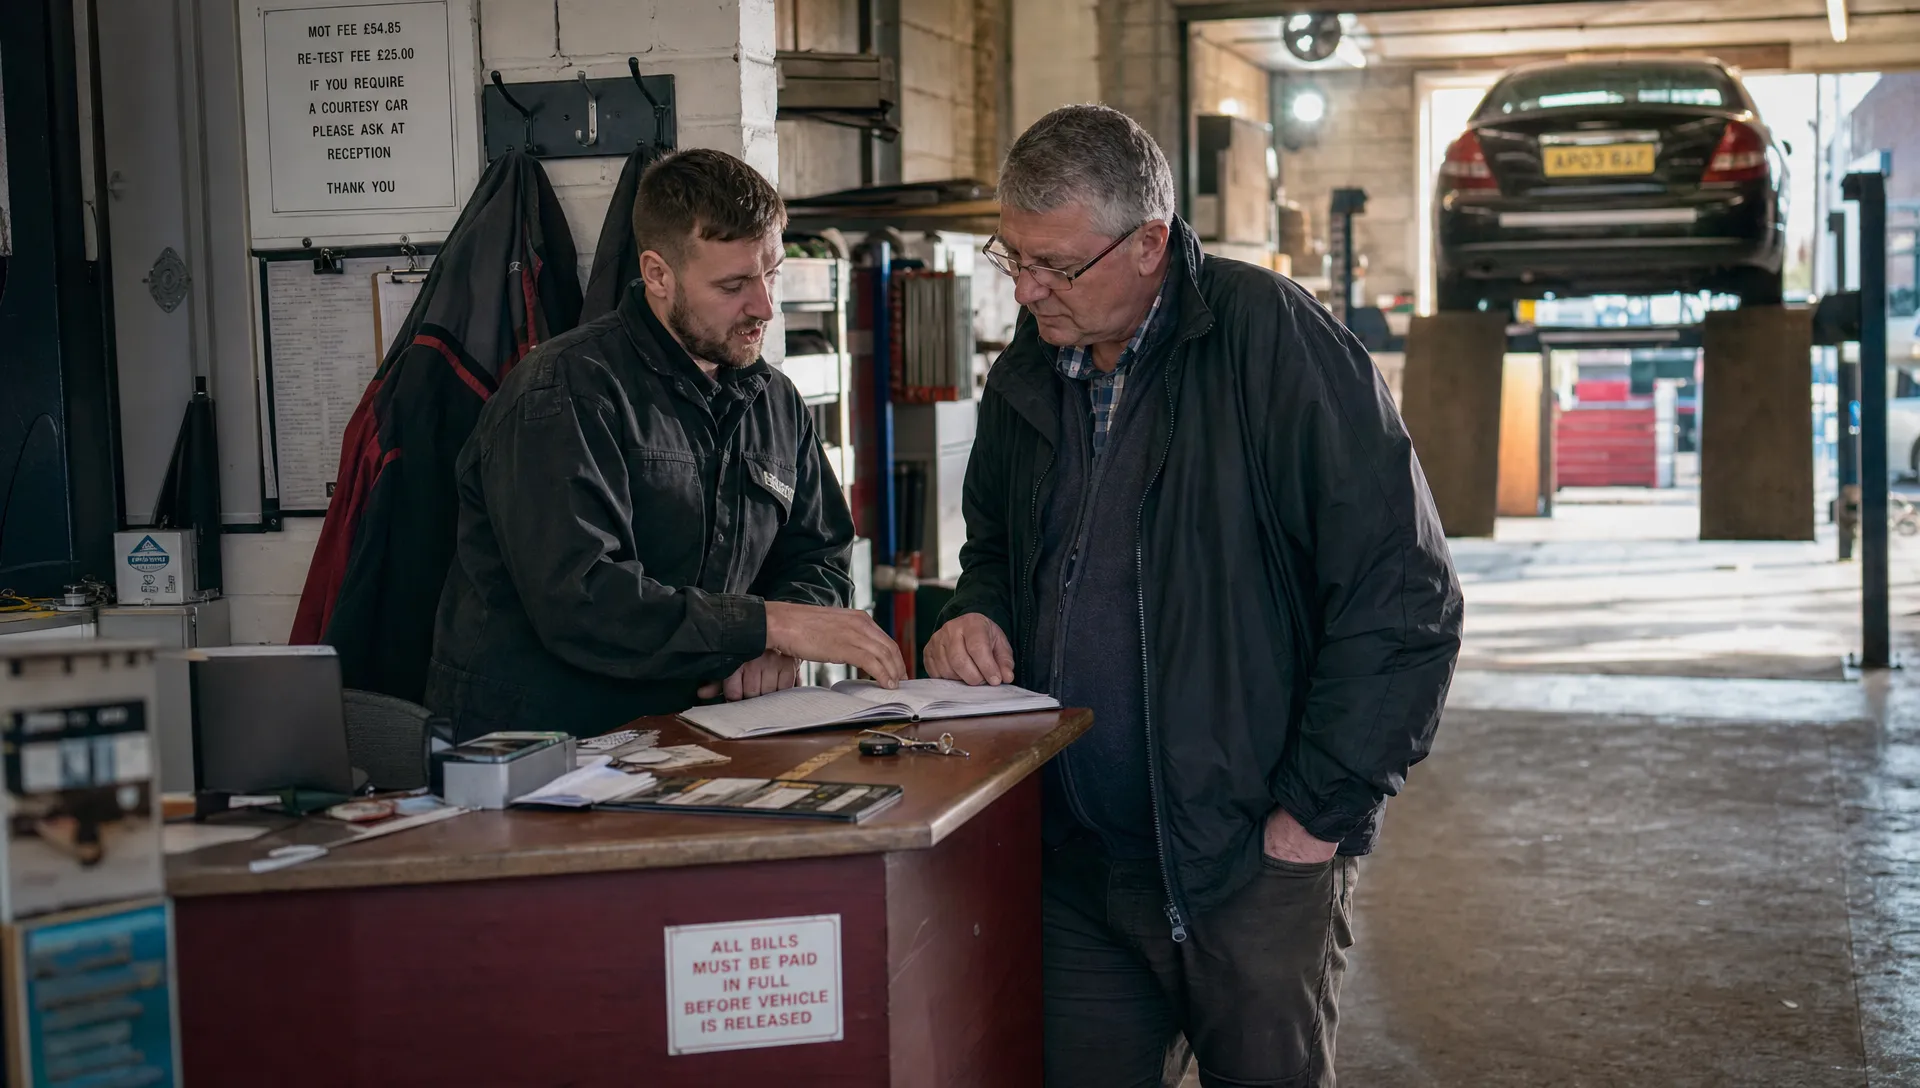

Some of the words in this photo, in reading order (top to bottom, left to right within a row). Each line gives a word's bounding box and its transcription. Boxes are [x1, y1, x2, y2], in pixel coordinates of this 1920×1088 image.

[308, 25, 331, 38] MOT
[337, 24, 357, 36] FEE
[363, 21, 401, 35] £54.85
[298, 51, 344, 64] RE-TEST
[350, 50, 371, 62] FEE
[377, 48, 414, 61] £25.00
[310, 79, 320, 91] IF
[326, 78, 348, 90] YOU
[354, 76, 405, 89] REQUIRE
[308, 102, 316, 114] A
[321, 100, 379, 114] COURTESY
[385, 99, 408, 111] CAR
[312, 124, 355, 137] PLEASE
[360, 123, 384, 135] ASK
[391, 122, 405, 134] AT
[327, 146, 391, 160] RECEPTION
[327, 181, 365, 194] THANK
[372, 180, 395, 193] YOU
[711, 940, 743, 954] ALL
[751, 934, 798, 951] BILLS
[692, 958, 741, 975] MUST
[750, 956, 771, 970] BE
[779, 952, 817, 968] PAID
[723, 978, 740, 992] IN
[748, 974, 789, 990] FULL
[684, 996, 752, 1015] BEFORE
[758, 989, 829, 1008] VEHICLE
[701, 1019, 717, 1034] IS
[724, 1011, 812, 1031] RELEASED
